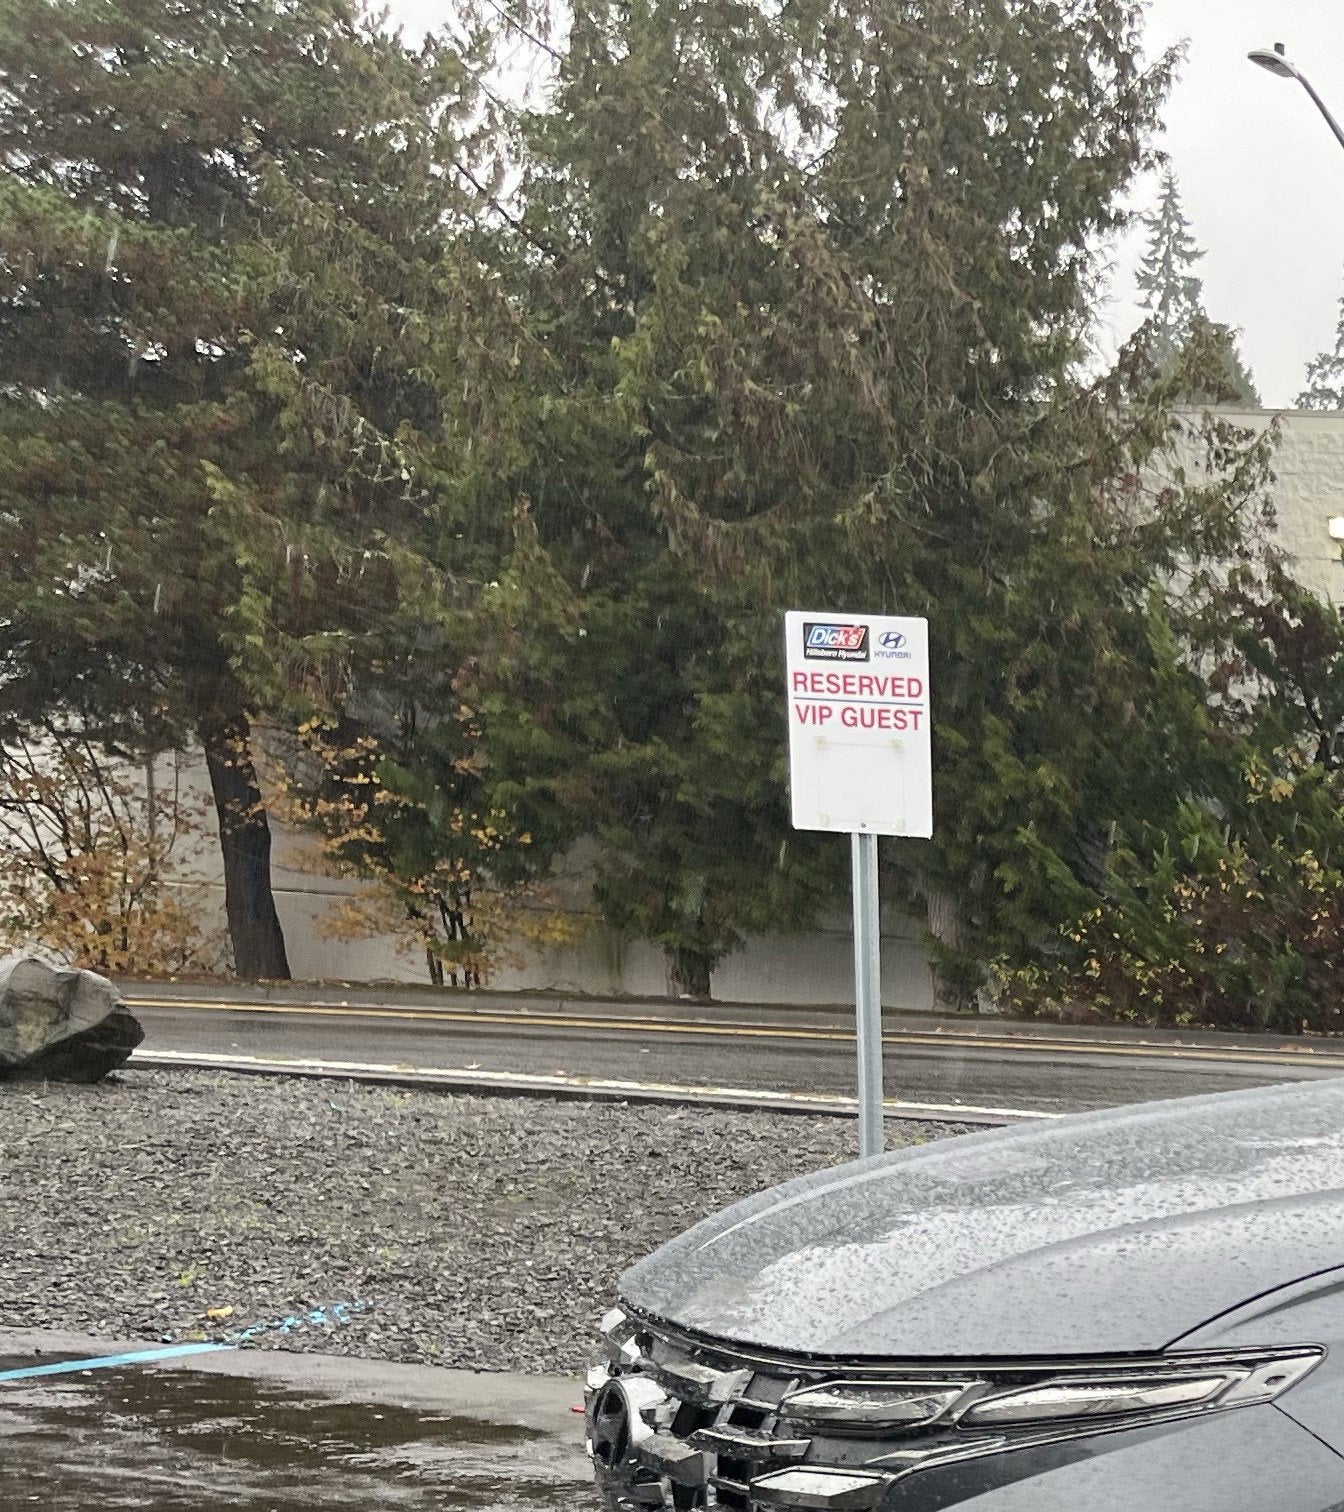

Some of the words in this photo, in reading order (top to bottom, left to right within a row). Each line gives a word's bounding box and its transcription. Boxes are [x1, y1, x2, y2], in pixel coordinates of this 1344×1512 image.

[874, 651, 912, 659] HYUNDAI
[793, 671, 923, 699] RESERVED
[795, 703, 833, 726] VIP
[841, 705, 923, 731] GUEST
